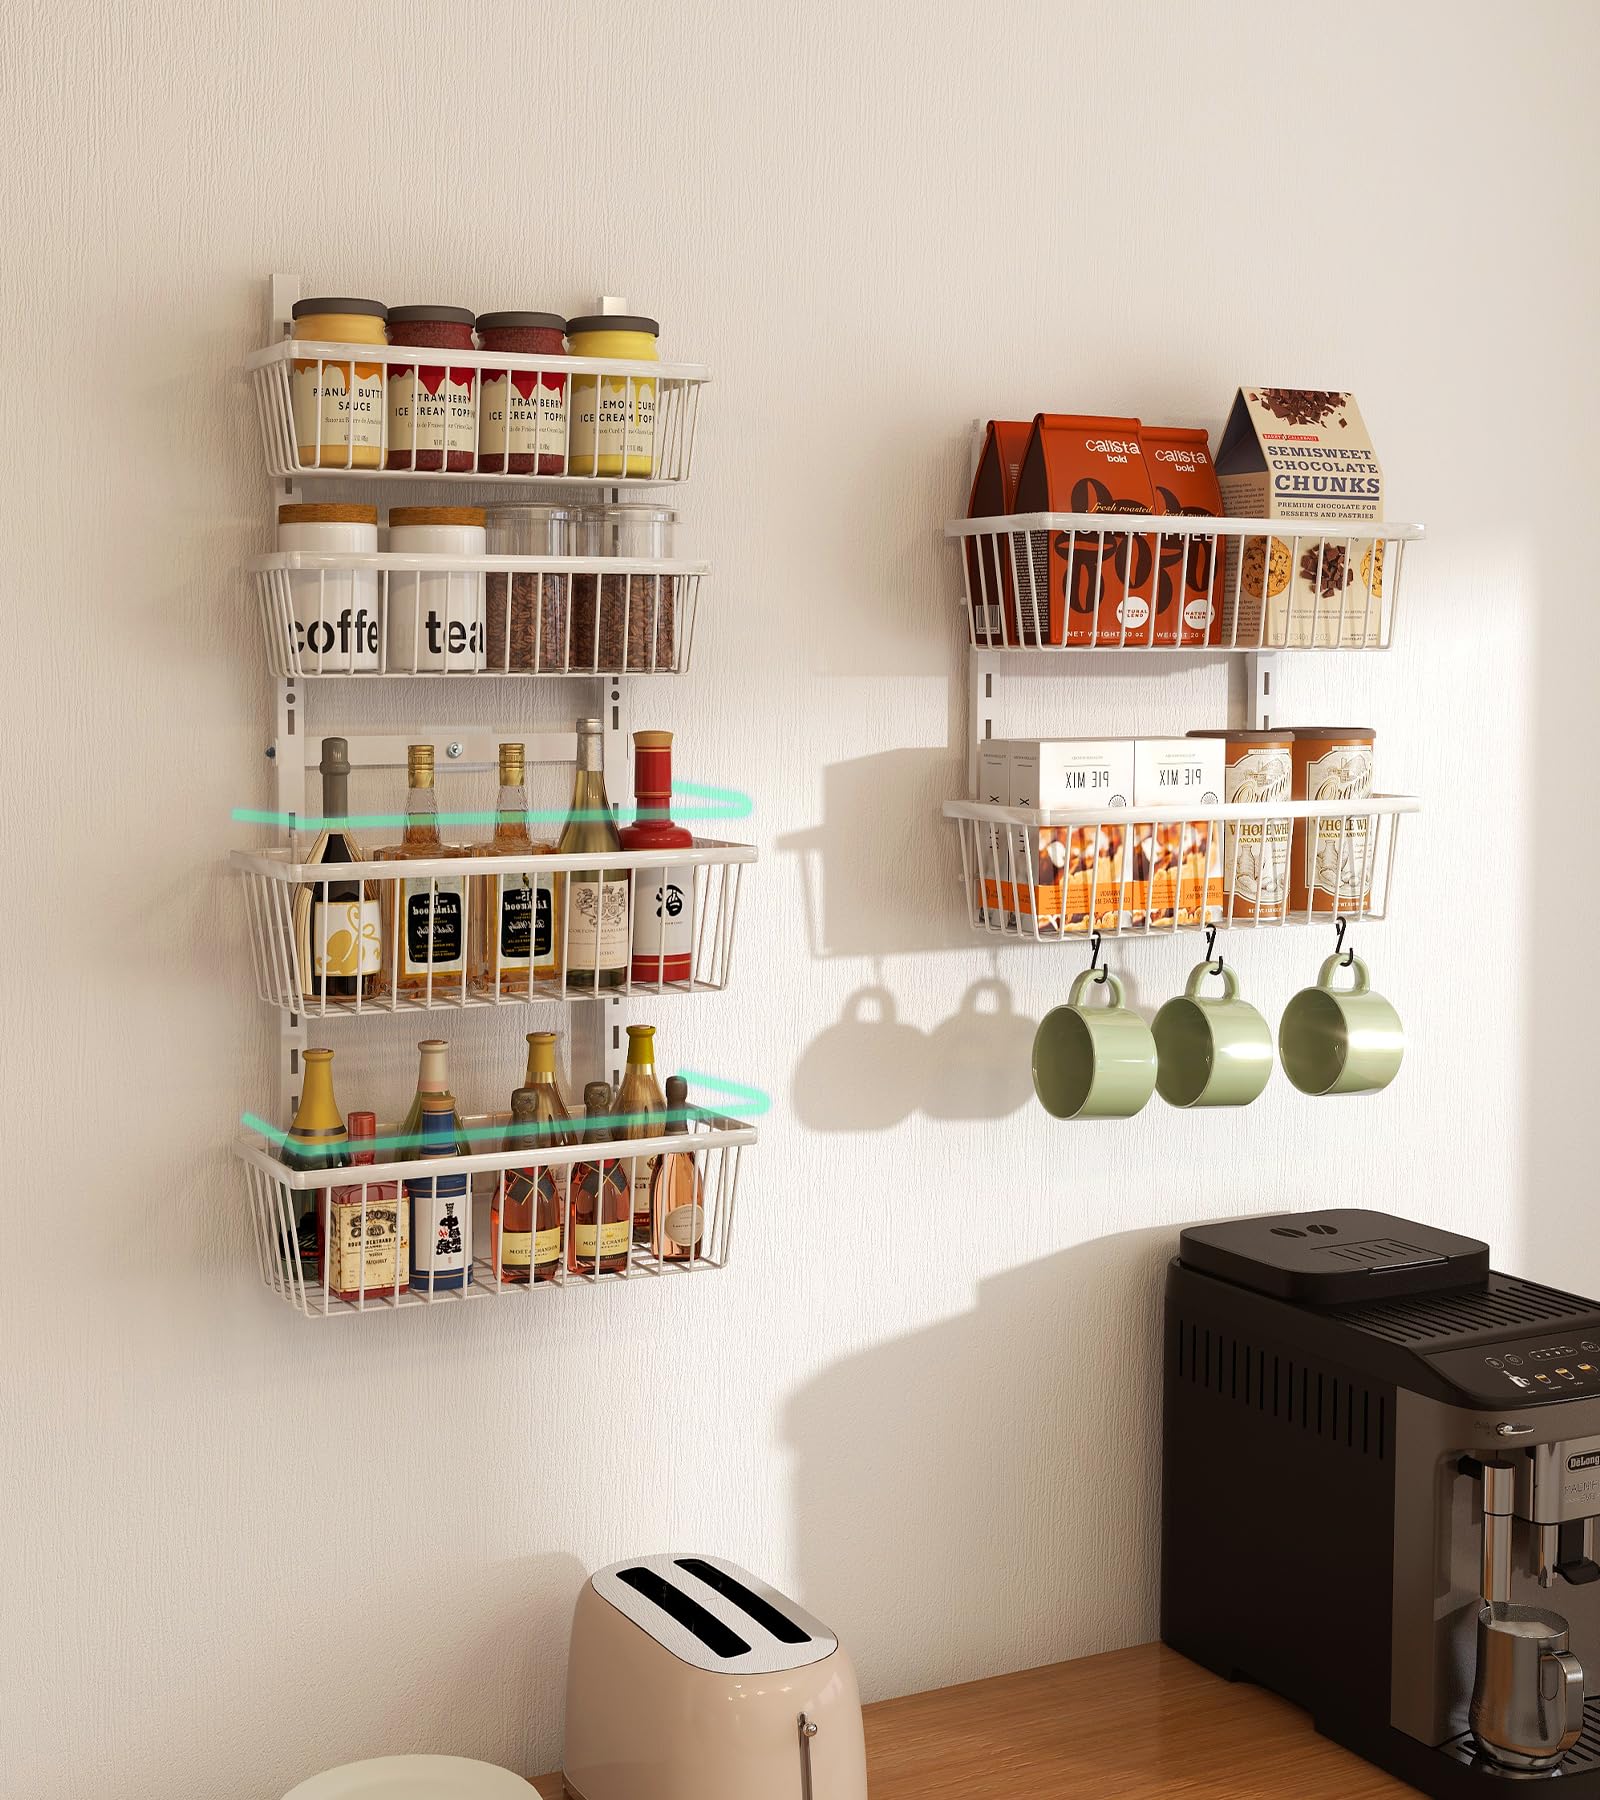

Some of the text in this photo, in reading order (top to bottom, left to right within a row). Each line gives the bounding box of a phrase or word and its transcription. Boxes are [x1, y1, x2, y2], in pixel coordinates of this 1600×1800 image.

[313, 387, 347, 397] PEANU
[338, 401, 371, 411] SAUCE
[505, 397, 562, 409] TRAWBERRY
[599, 400, 633, 409] EMON
[395, 407, 409, 416] ICE
[417, 407, 446, 416] REAM
[489, 411, 503, 421] ICE
[580, 414, 594, 422] ICE
[1268, 446, 1371, 460] SEMISWEET
[1106, 454, 1128, 463] bold
[1175, 464, 1195, 472] bold
[1272, 460, 1378, 474] CHOCOLATE
[1275, 475, 1380, 494] CHUNKS
[1118, 504, 1153, 514] roasted
[1315, 502, 1360, 510] CHOCOLATE
[1280, 510, 1319, 518] DESSERTS
[425, 610, 484, 654] tea
